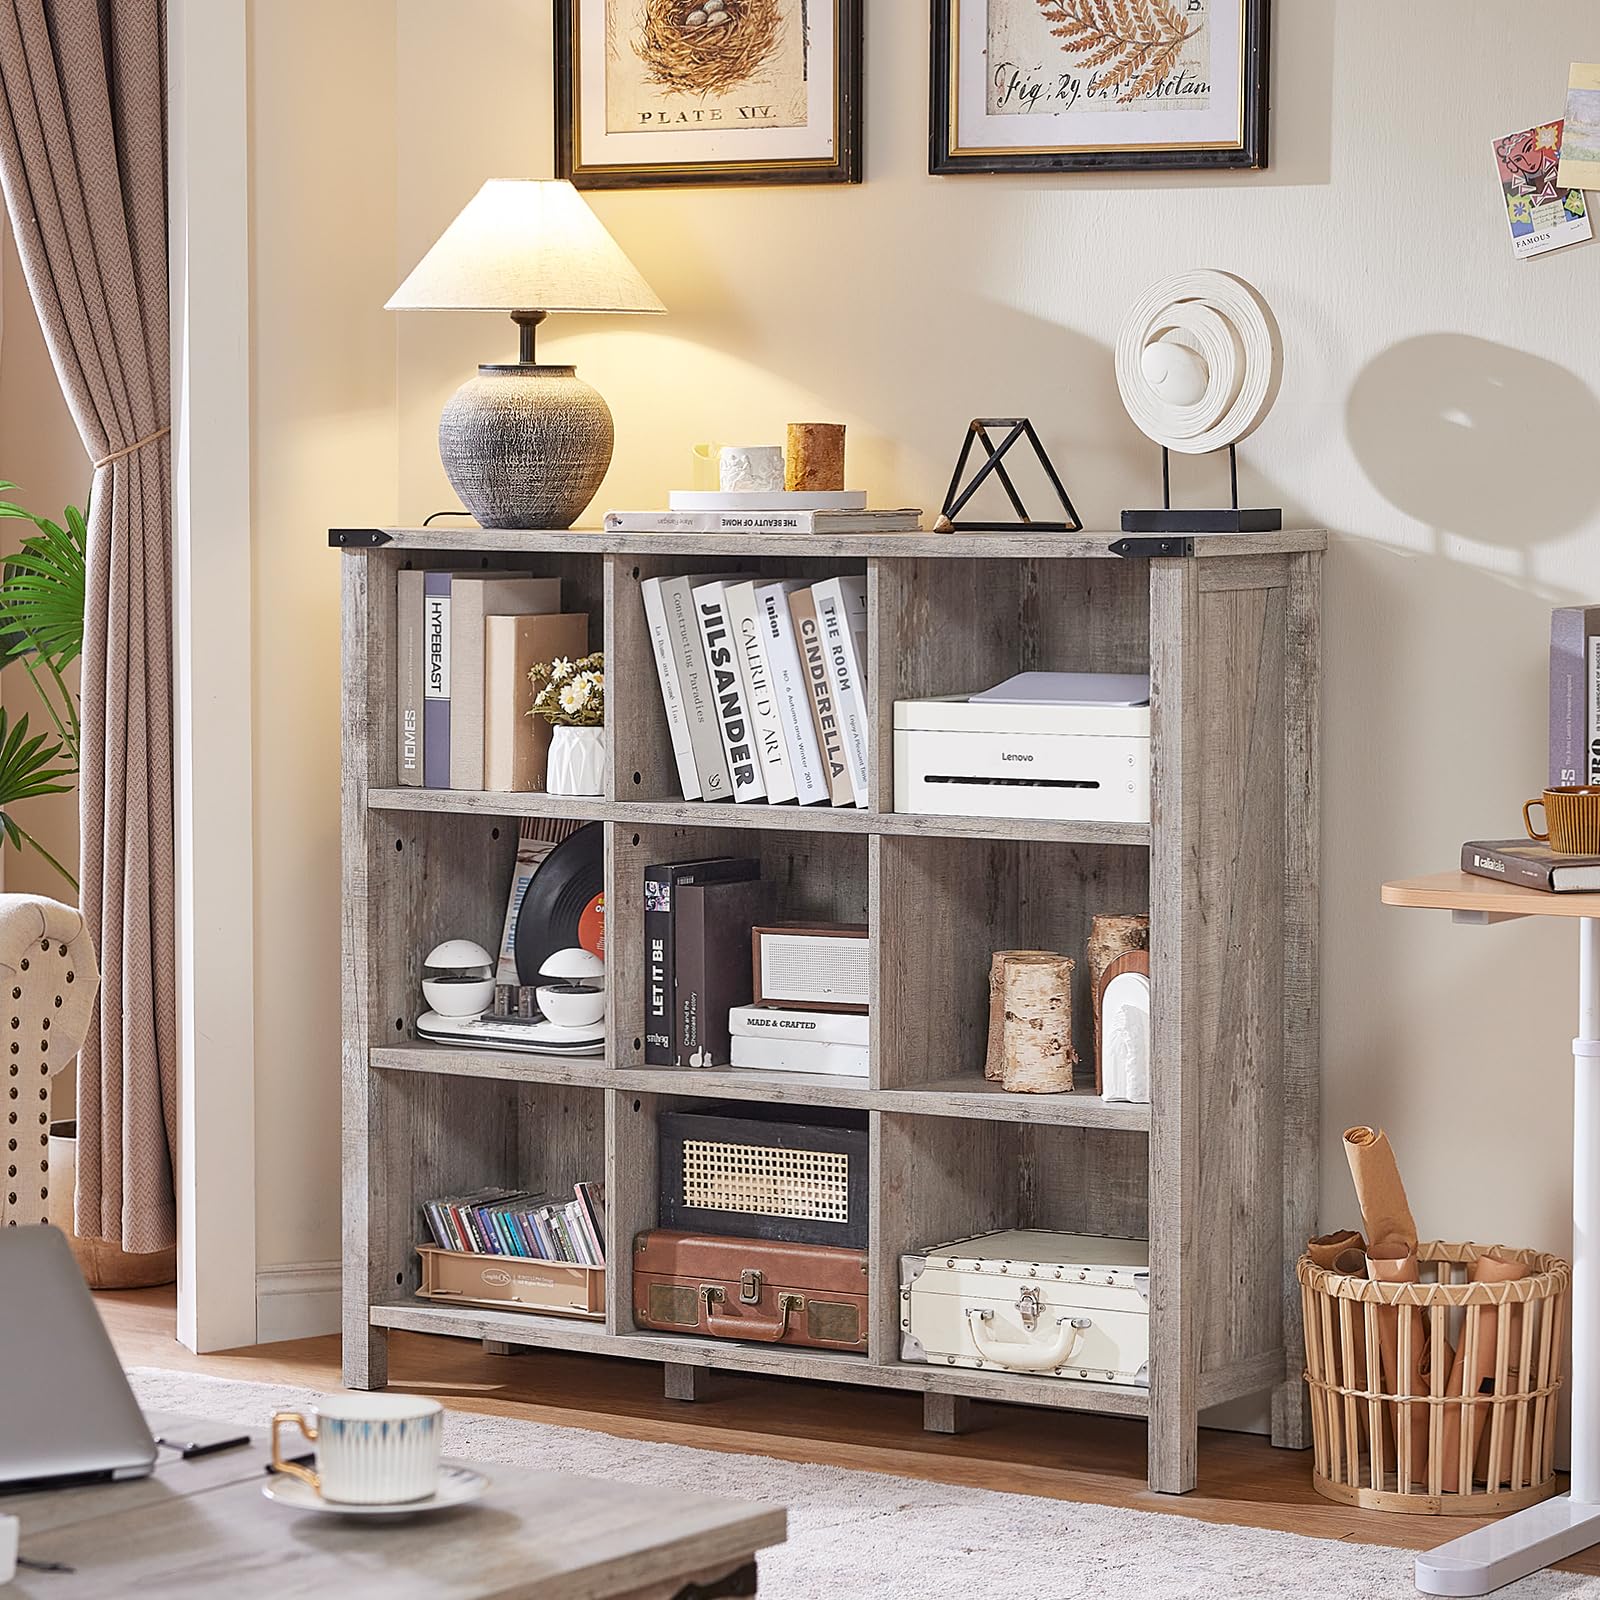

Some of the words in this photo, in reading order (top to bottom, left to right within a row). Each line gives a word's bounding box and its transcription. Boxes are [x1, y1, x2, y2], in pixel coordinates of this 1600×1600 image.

[637, 108, 723, 125] PLATE
[1516, 233, 1551, 248] FAMOUS
[722, 518, 743, 527] HOME
[744, 519, 753, 527] OF
[755, 519, 782, 527] BEAUTY
[783, 519, 798, 527] THE
[765, 596, 780, 639] Union
[673, 592, 694, 668] Constructing
[430, 602, 442, 693] HYPEBEAST
[824, 606, 840, 638] THE
[832, 645, 851, 691] ROOM
[701, 603, 754, 789] JILSANDER
[801, 619, 845, 778] CINDERELLA
[404, 709, 416, 769] HOMES
[787, 695, 798, 726] Autumn
[798, 742, 808, 769] Winter
[762, 728, 783, 767] ART
[1001, 752, 1034, 762] Lenovo
[652, 939, 664, 962] BE
[652, 966, 664, 982] IT
[652, 984, 664, 1016] LET
[690, 991, 698, 1015] Factory
[746, 1018, 771, 1027] MADE
[780, 1020, 817, 1030] CRAFTED
